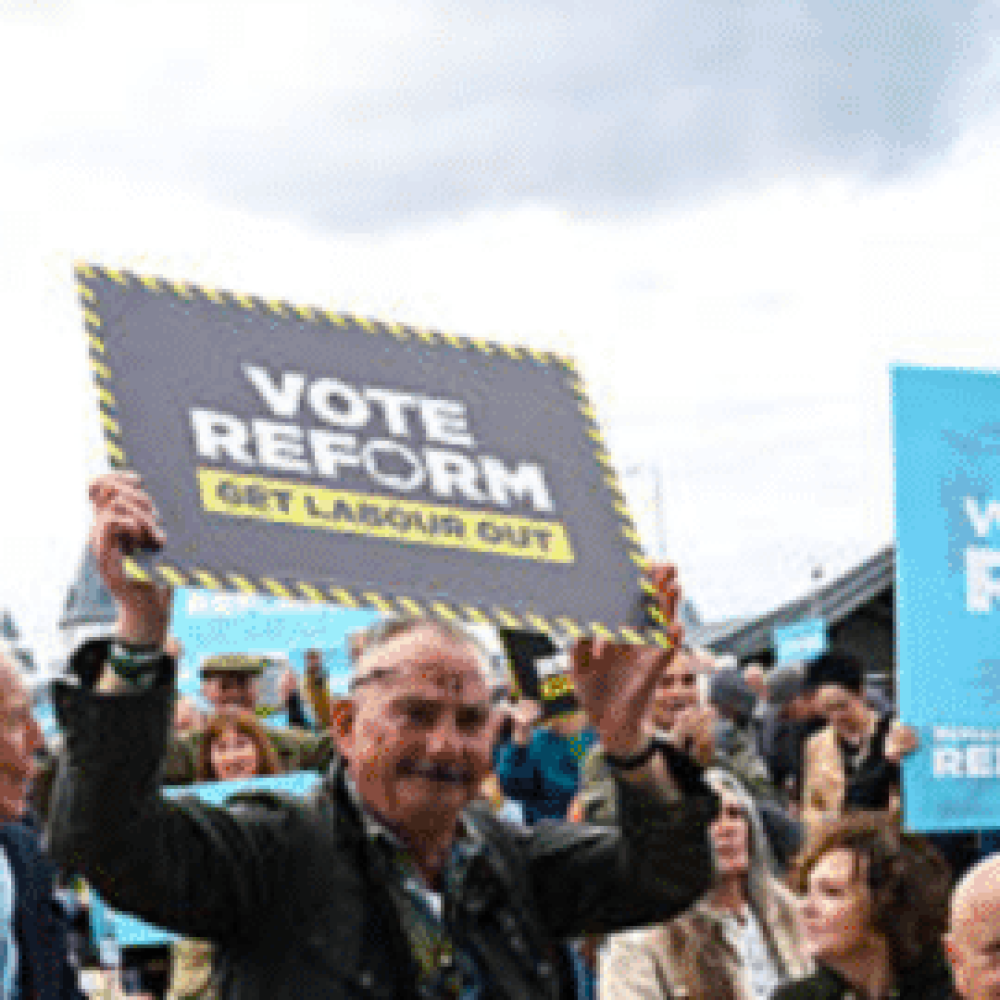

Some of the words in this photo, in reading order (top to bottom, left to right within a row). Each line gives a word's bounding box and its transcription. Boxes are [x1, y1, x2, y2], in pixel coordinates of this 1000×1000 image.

[241, 363, 475, 447] VOTE
[189, 407, 555, 512] REFORM
[215, 480, 292, 514] GET
[304, 495, 466, 537] LABOUR
[477, 520, 553, 551] OUT
